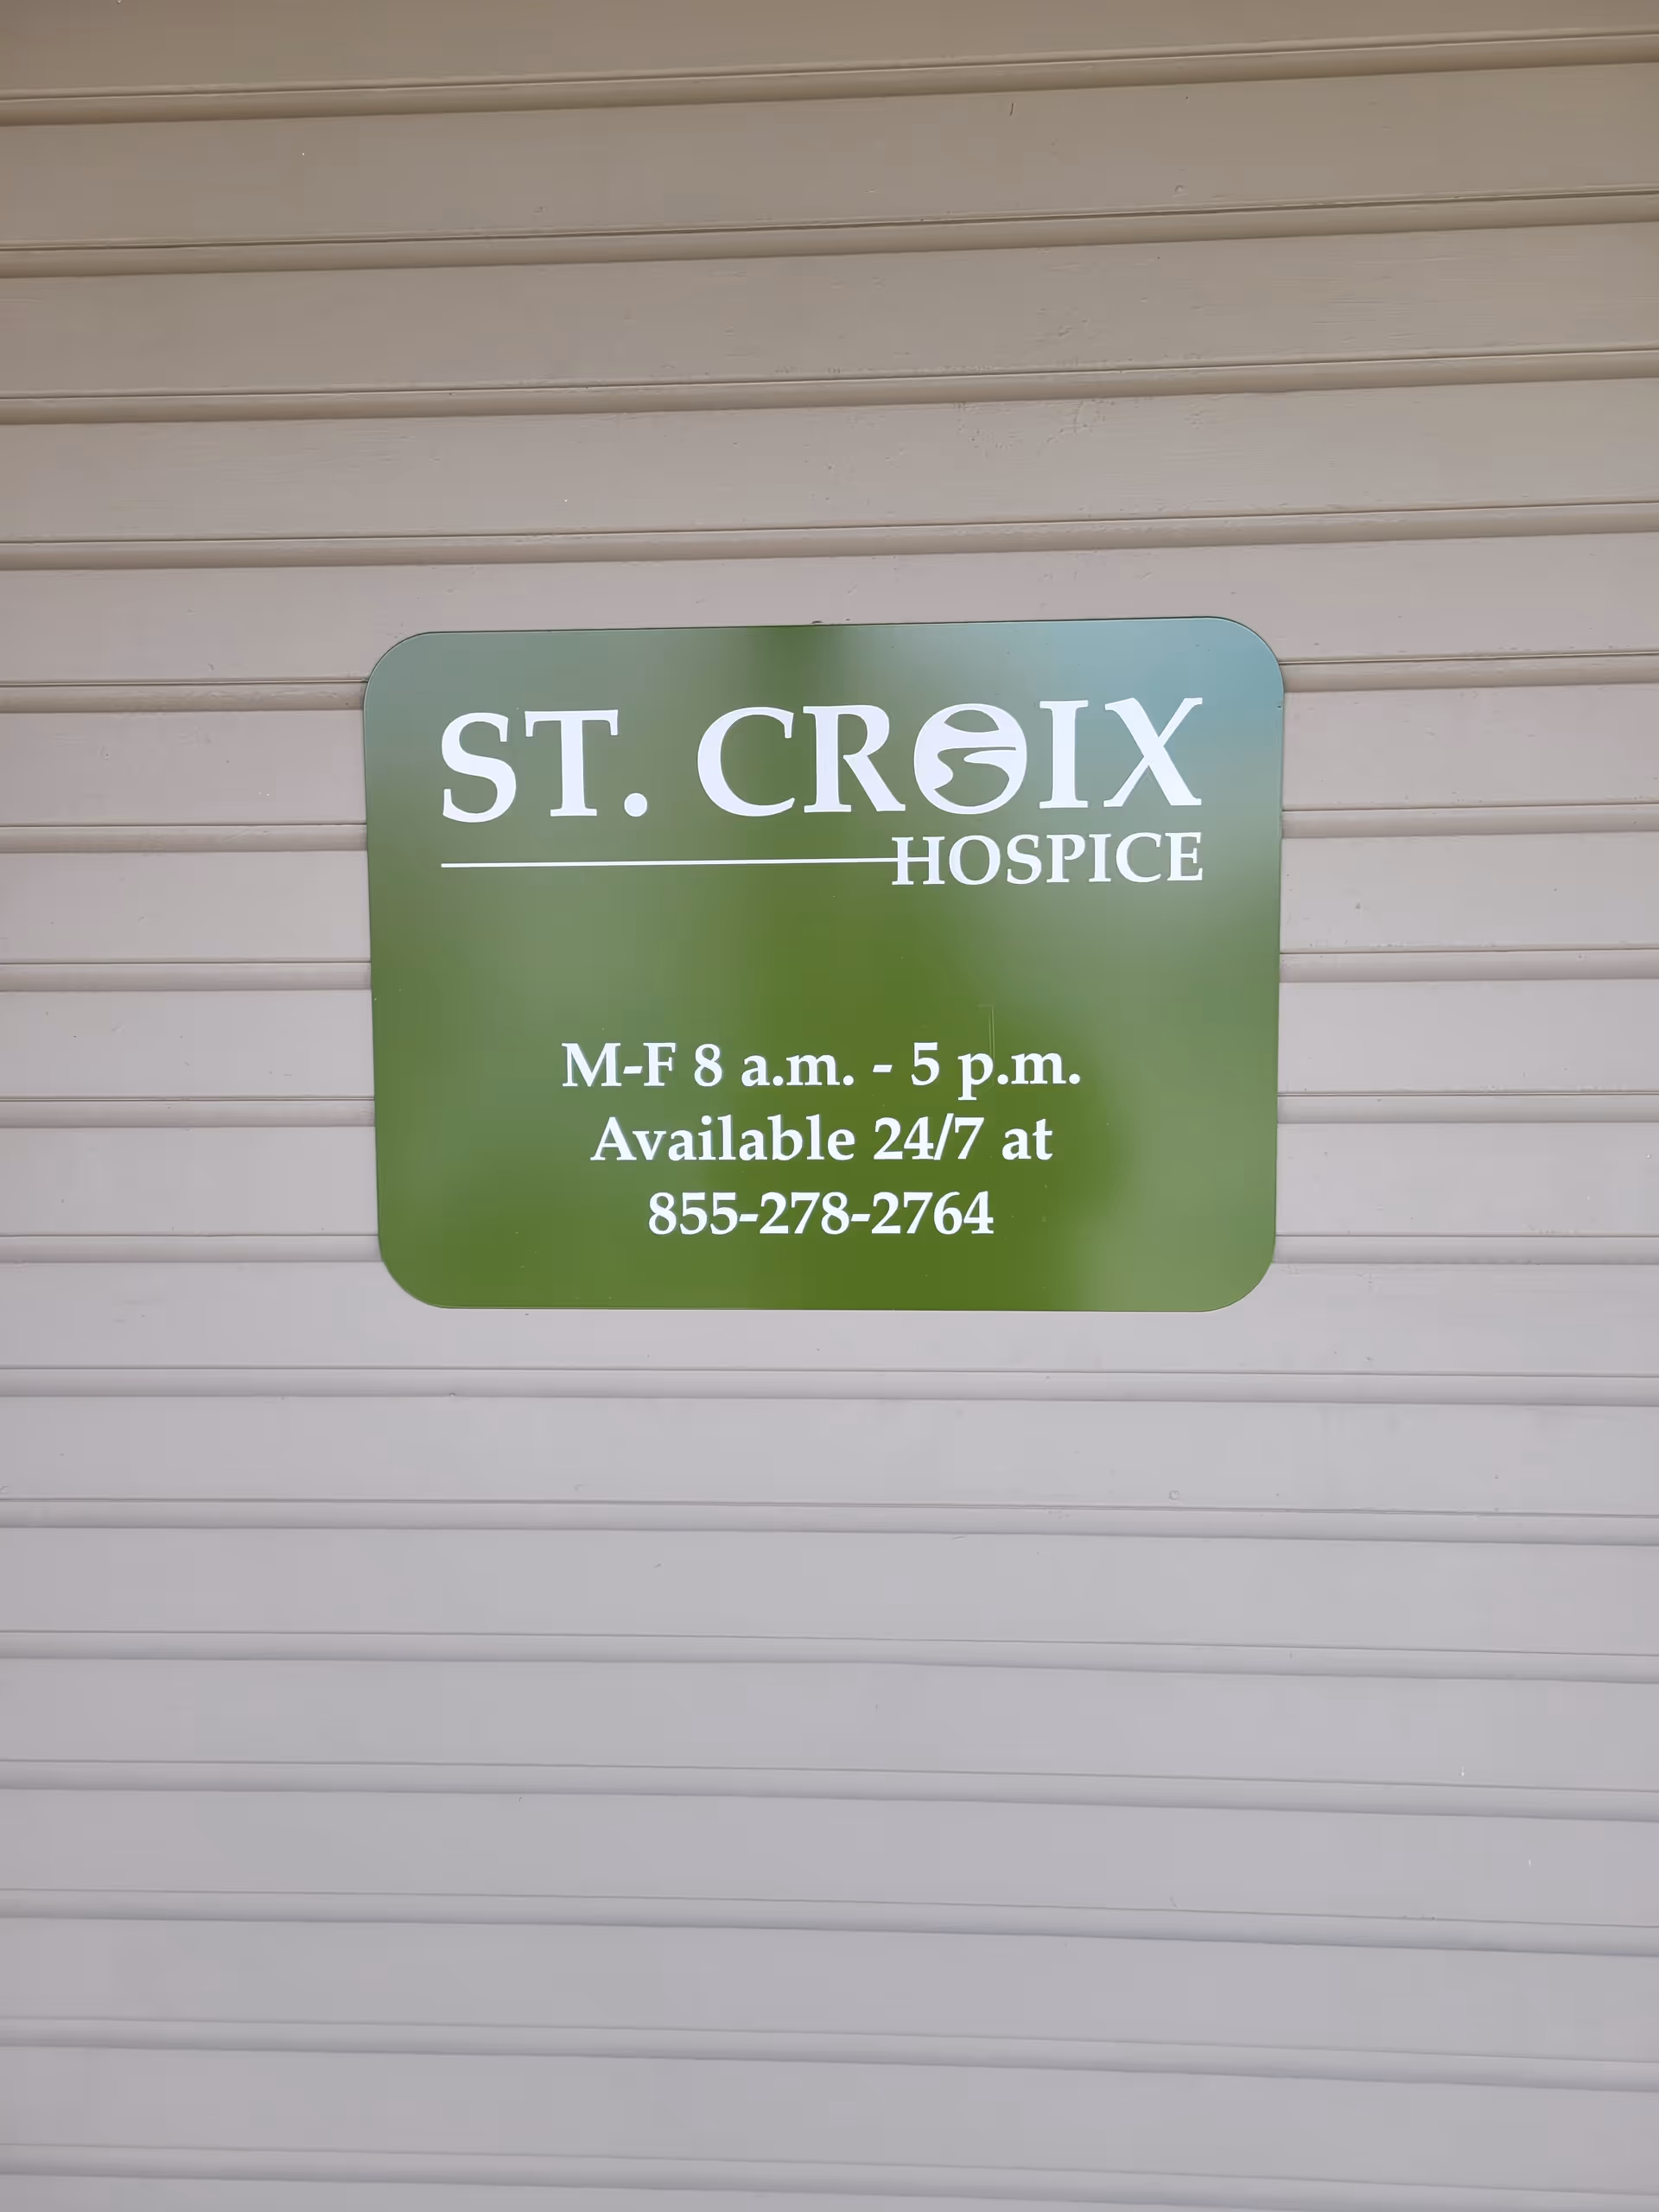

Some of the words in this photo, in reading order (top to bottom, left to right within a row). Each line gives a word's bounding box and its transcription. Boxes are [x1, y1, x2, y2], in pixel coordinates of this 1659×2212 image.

[442, 709, 648, 823] ST.
[697, 696, 1205, 817] CROIX
[893, 831, 1205, 887] HOSPICE
[562, 1042, 677, 1087] M-F
[694, 1043, 722, 1087] 8
[741, 1054, 855, 1087] a.m.
[872, 1065, 893, 1073] -
[912, 1041, 940, 1086] 5
[957, 1052, 1081, 1101] p.m.
[590, 1114, 855, 1161] Available
[874, 1113, 985, 1160] 24/7
[1001, 1118, 1053, 1160] at
[648, 1191, 995, 1236] 855-278-2764
